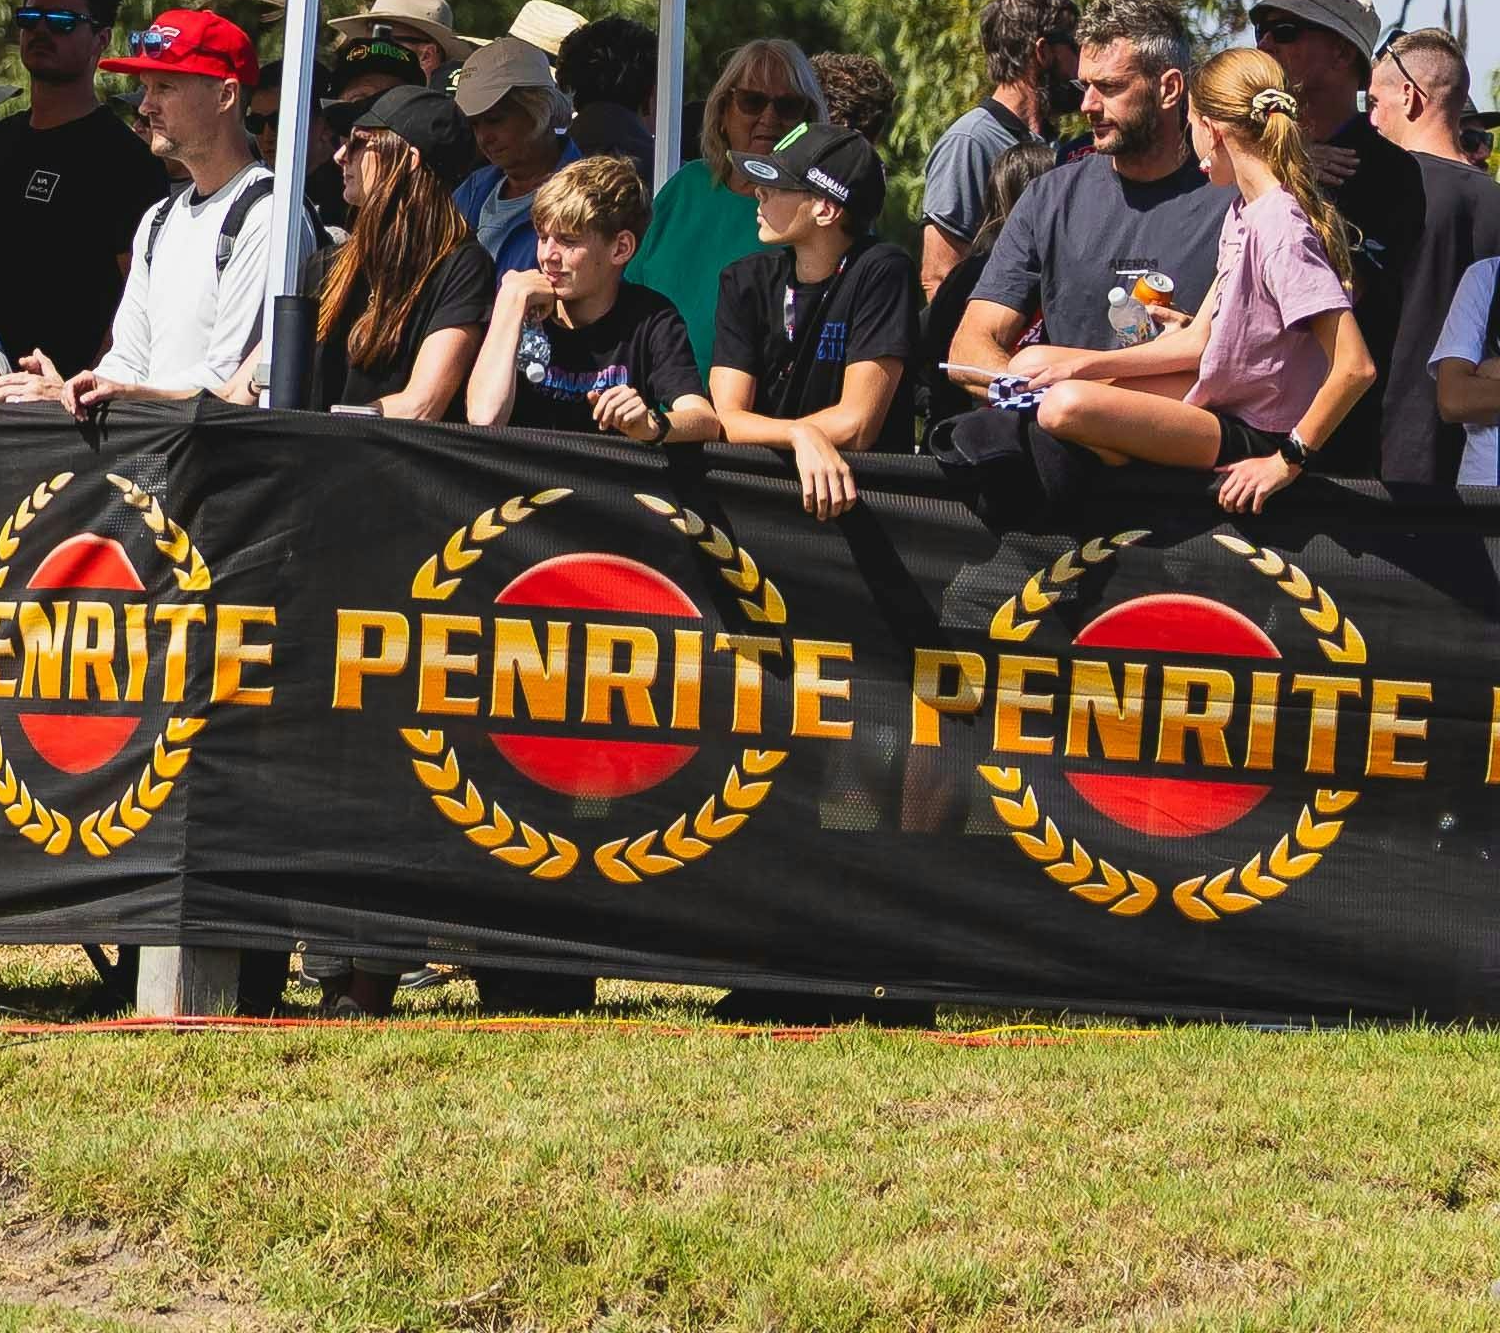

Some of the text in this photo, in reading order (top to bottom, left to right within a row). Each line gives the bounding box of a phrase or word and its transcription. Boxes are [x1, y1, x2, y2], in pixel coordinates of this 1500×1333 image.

[814, 171, 850, 198] YAMAHA
[330, 607, 856, 742] PENRITE
[910, 646, 1436, 783] PENRITE
